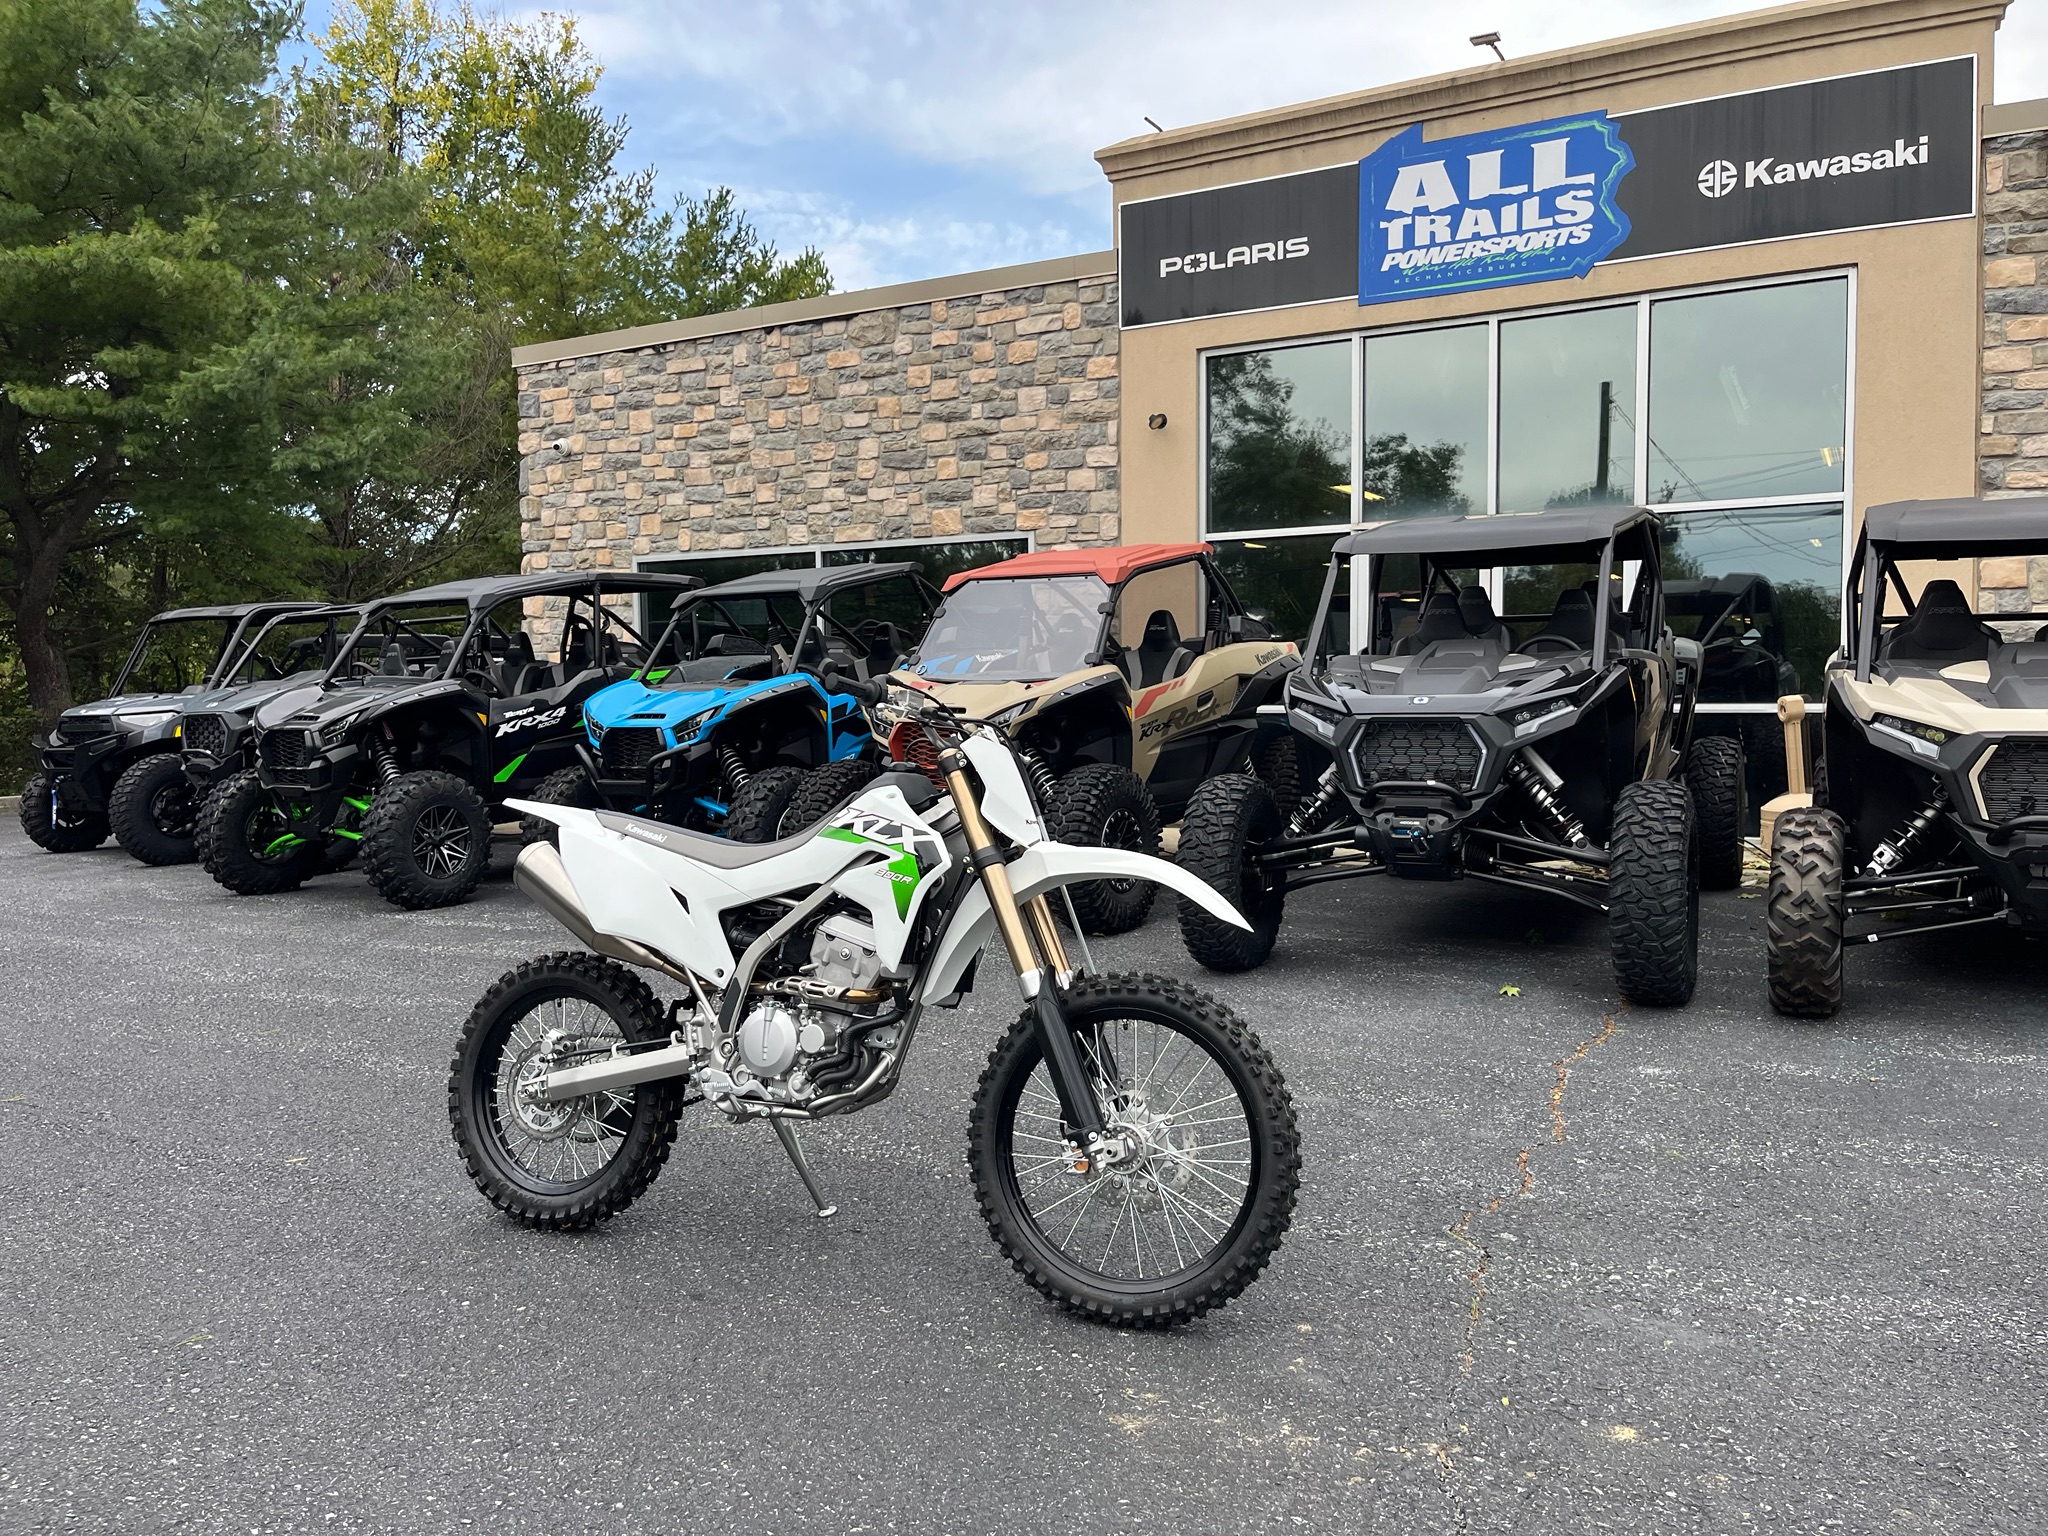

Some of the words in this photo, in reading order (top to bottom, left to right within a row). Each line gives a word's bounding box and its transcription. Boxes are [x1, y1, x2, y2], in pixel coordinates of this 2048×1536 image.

[1385, 137, 1595, 214] ALL
[1744, 135, 1929, 188] Kawasaki
[1380, 189, 1594, 250] TRAILS
[1159, 236, 1310, 278] POLARIS
[1380, 223, 1593, 272] POWERSPORTS
[1448, 257, 1477, 270] All
[1480, 251, 1519, 265] Trails
[1550, 255, 1566, 263] PA
[1254, 645, 1284, 667] Kawasaki
[495, 706, 567, 738] KRX4
[537, 718, 561, 729] 1000
[624, 822, 668, 843] Kawasaki
[829, 806, 932, 856] KLX
[874, 868, 914, 885] 300R
